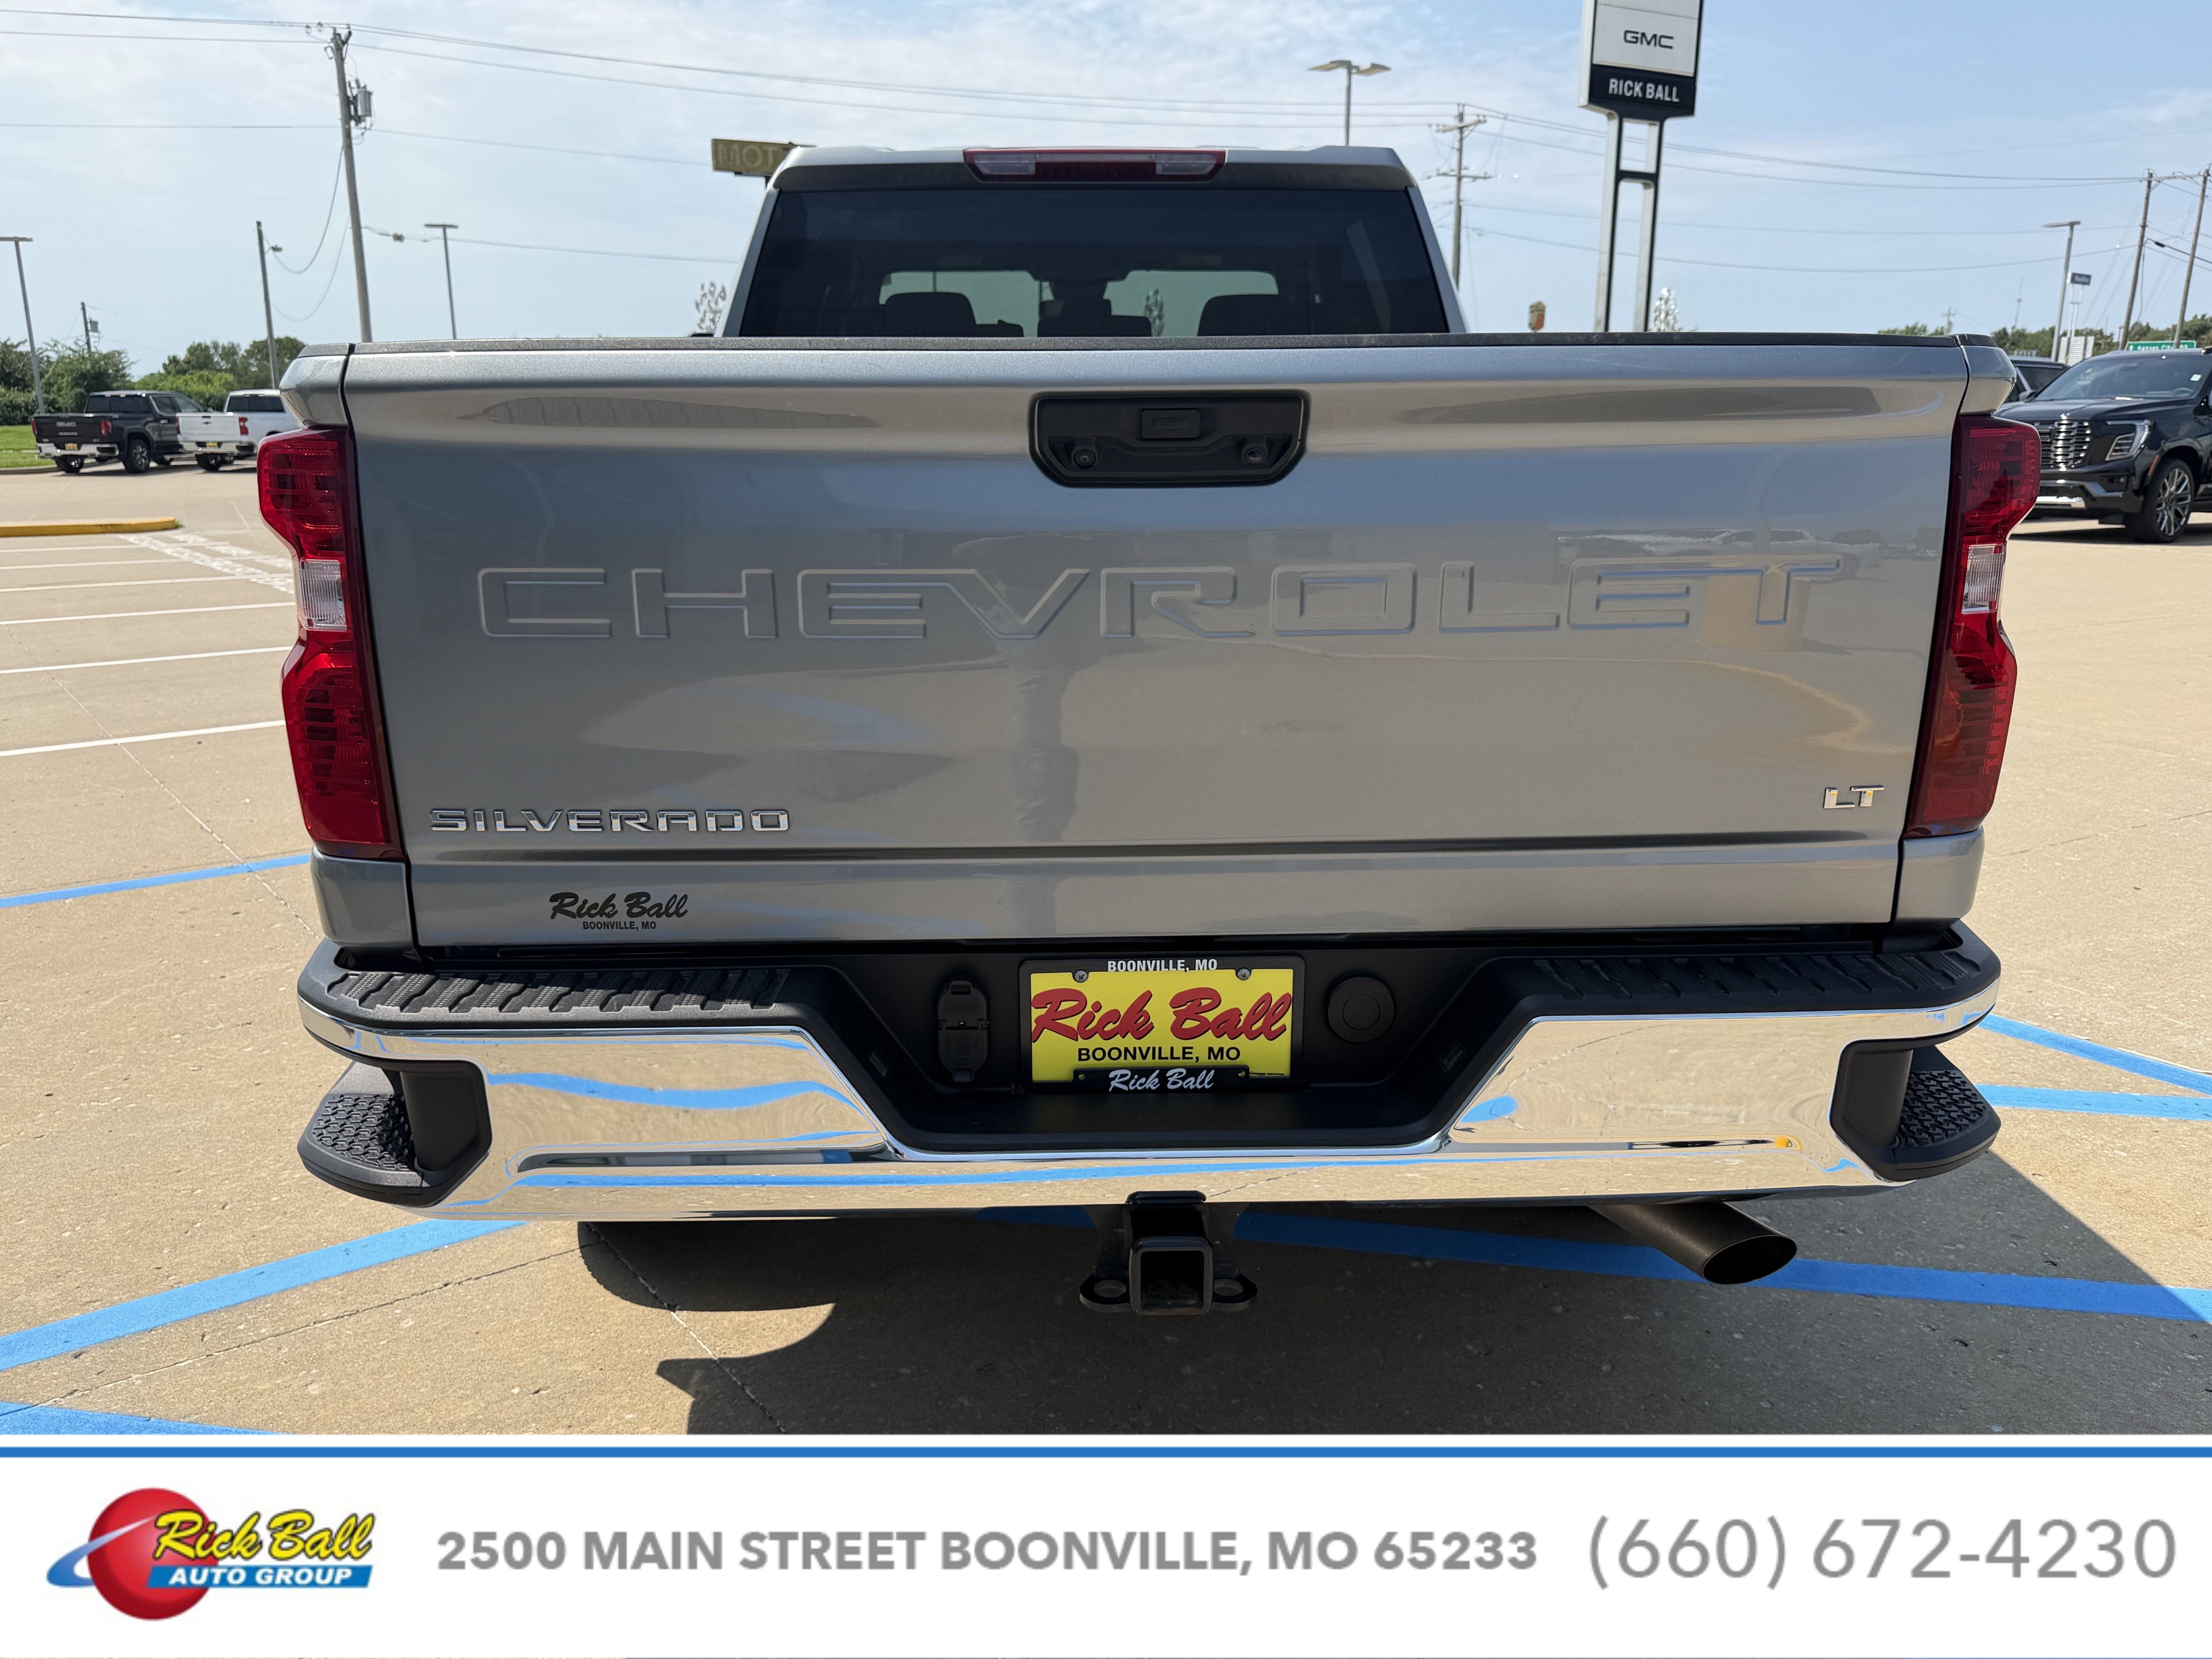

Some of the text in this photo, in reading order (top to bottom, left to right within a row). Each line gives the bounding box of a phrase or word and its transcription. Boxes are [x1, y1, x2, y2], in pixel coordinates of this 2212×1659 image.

[1624, 30, 1674, 49] GMC
[1609, 78, 1680, 102] RICK BALL
[478, 554, 1843, 640] CHEVROLET
[1823, 785, 1884, 809] LT
[430, 809, 791, 832] SILVERADO
[549, 891, 688, 920] Rick Ball
[583, 921, 656, 931] BOONVILLE, MO
[1108, 959, 1218, 973] BOONVILLE, MO
[1032, 987, 1291, 1043] Rick Ball
[1078, 1046, 1240, 1062] BOONVILLE, MO
[1109, 1068, 1215, 1092] Rick Ball
